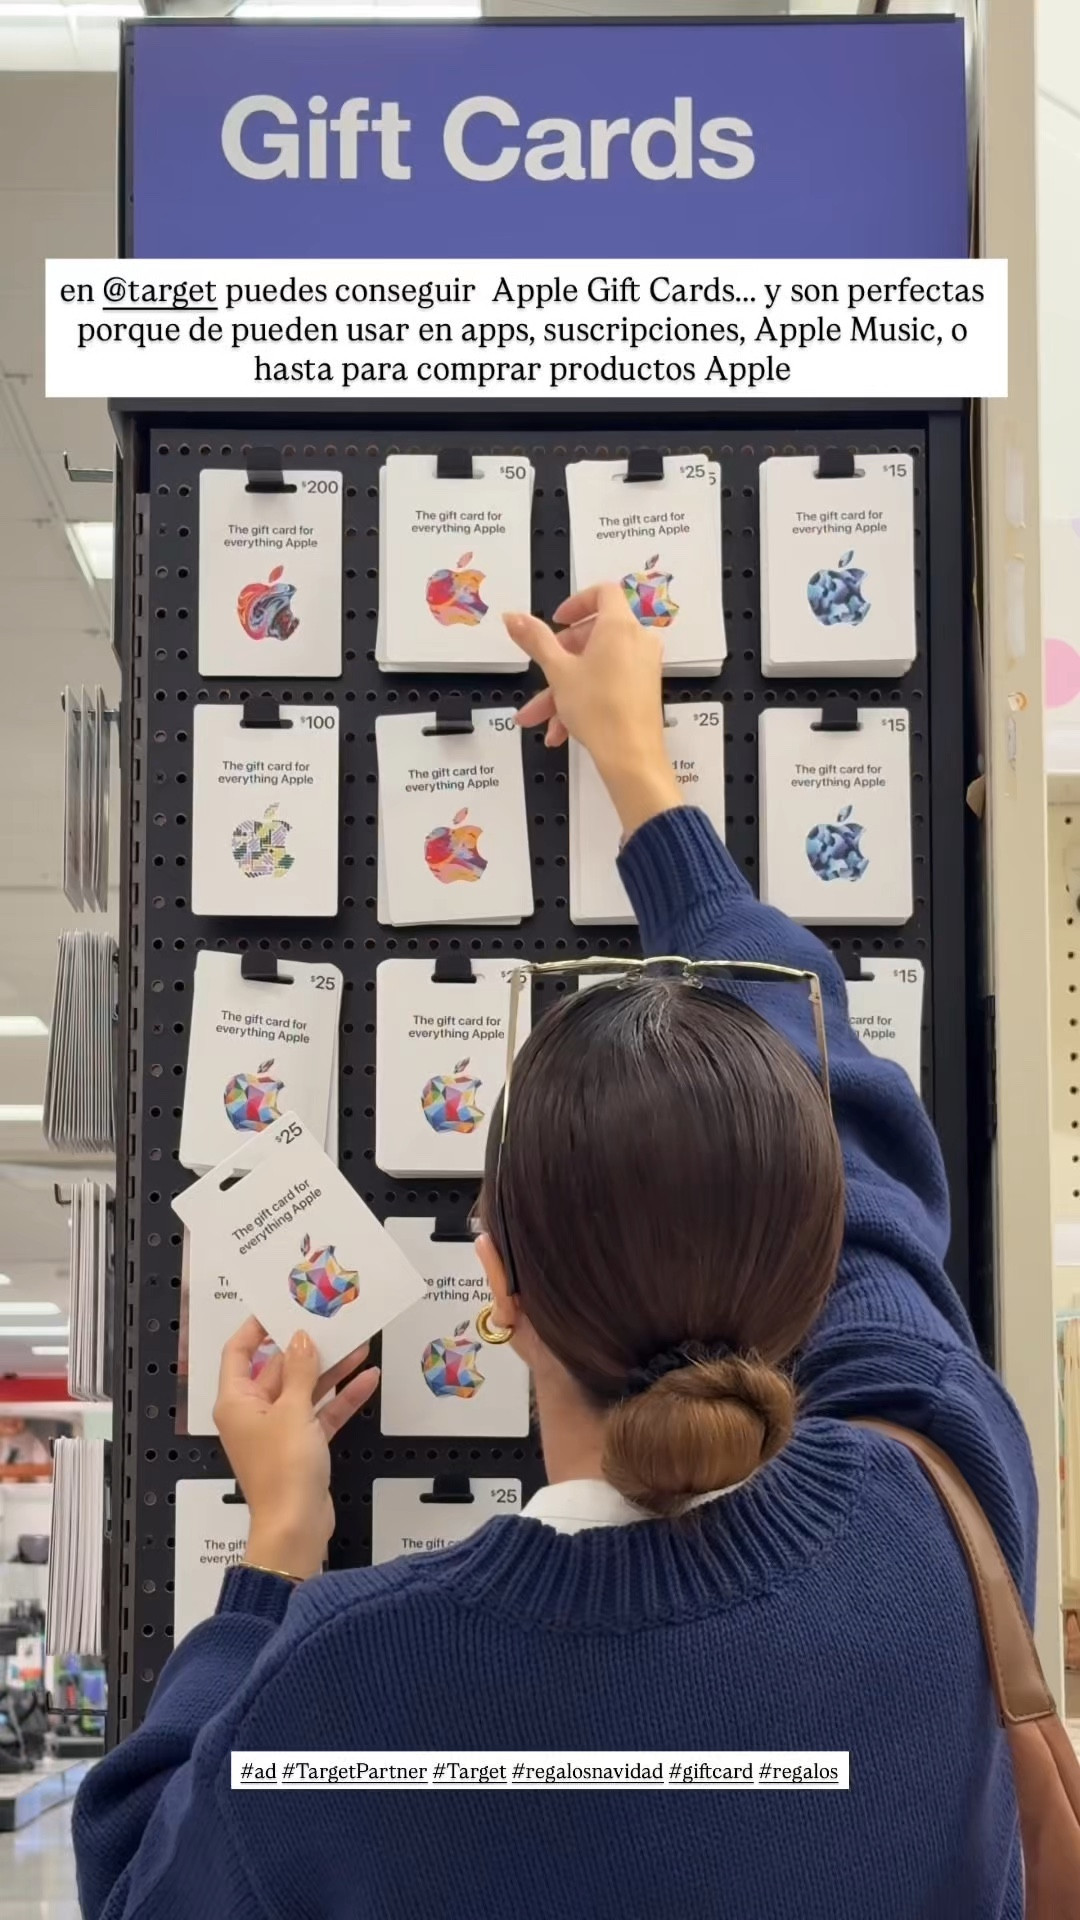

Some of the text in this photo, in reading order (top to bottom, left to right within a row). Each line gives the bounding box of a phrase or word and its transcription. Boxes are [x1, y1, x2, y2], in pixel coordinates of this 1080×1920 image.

[222, 95, 754, 181] Gift Cards
[500, 465, 527, 480] $50
[680, 464, 706, 479] $25
[883, 464, 908, 478] $15
[301, 480, 339, 495] $200
[415, 510, 503, 524] The gift card for
[599, 511, 685, 527] The gift card for
[796, 510, 884, 524] The gift card for
[228, 525, 314, 538] The gift card for
[411, 523, 506, 536] everything Apple
[596, 524, 691, 541] everything Apple
[791, 522, 888, 536] everything Apple
[223, 537, 318, 550] everything Apple
[301, 715, 336, 730] $100
[694, 712, 720, 727] $25
[882, 718, 907, 733] $15
[222, 760, 310, 774] The gift card for
[680, 759, 695, 770] for
[795, 764, 883, 777] The gift card for
[218, 773, 314, 786] everything Apple
[408, 765, 495, 781] The gift card for
[675, 773, 699, 785] pple
[405, 777, 500, 793] everything Apple
[791, 775, 887, 789] everything Apple
[310, 976, 336, 991] $25
[894, 970, 918, 984] $15
[221, 1010, 308, 1031] The gift card for
[413, 1015, 502, 1029] The gift card for
[850, 1015, 893, 1026] card for
[216, 1025, 311, 1044] everything Apple
[408, 1028, 505, 1041] everything Apple
[862, 1028, 897, 1041] Apple
[275, 1121, 302, 1144] $25
[232, 1179, 310, 1240] The gift card for
[239, 1188, 322, 1255] everything Apple
[436, 1276, 456, 1289] gift
[458, 1276, 484, 1287] card
[422, 1289, 491, 1302] rything App
[490, 1489, 518, 1504] $25
[204, 1539, 247, 1552] The gift
[401, 1537, 424, 1549] The
[425, 1537, 445, 1551] gift
[199, 1553, 243, 1565] everyth
